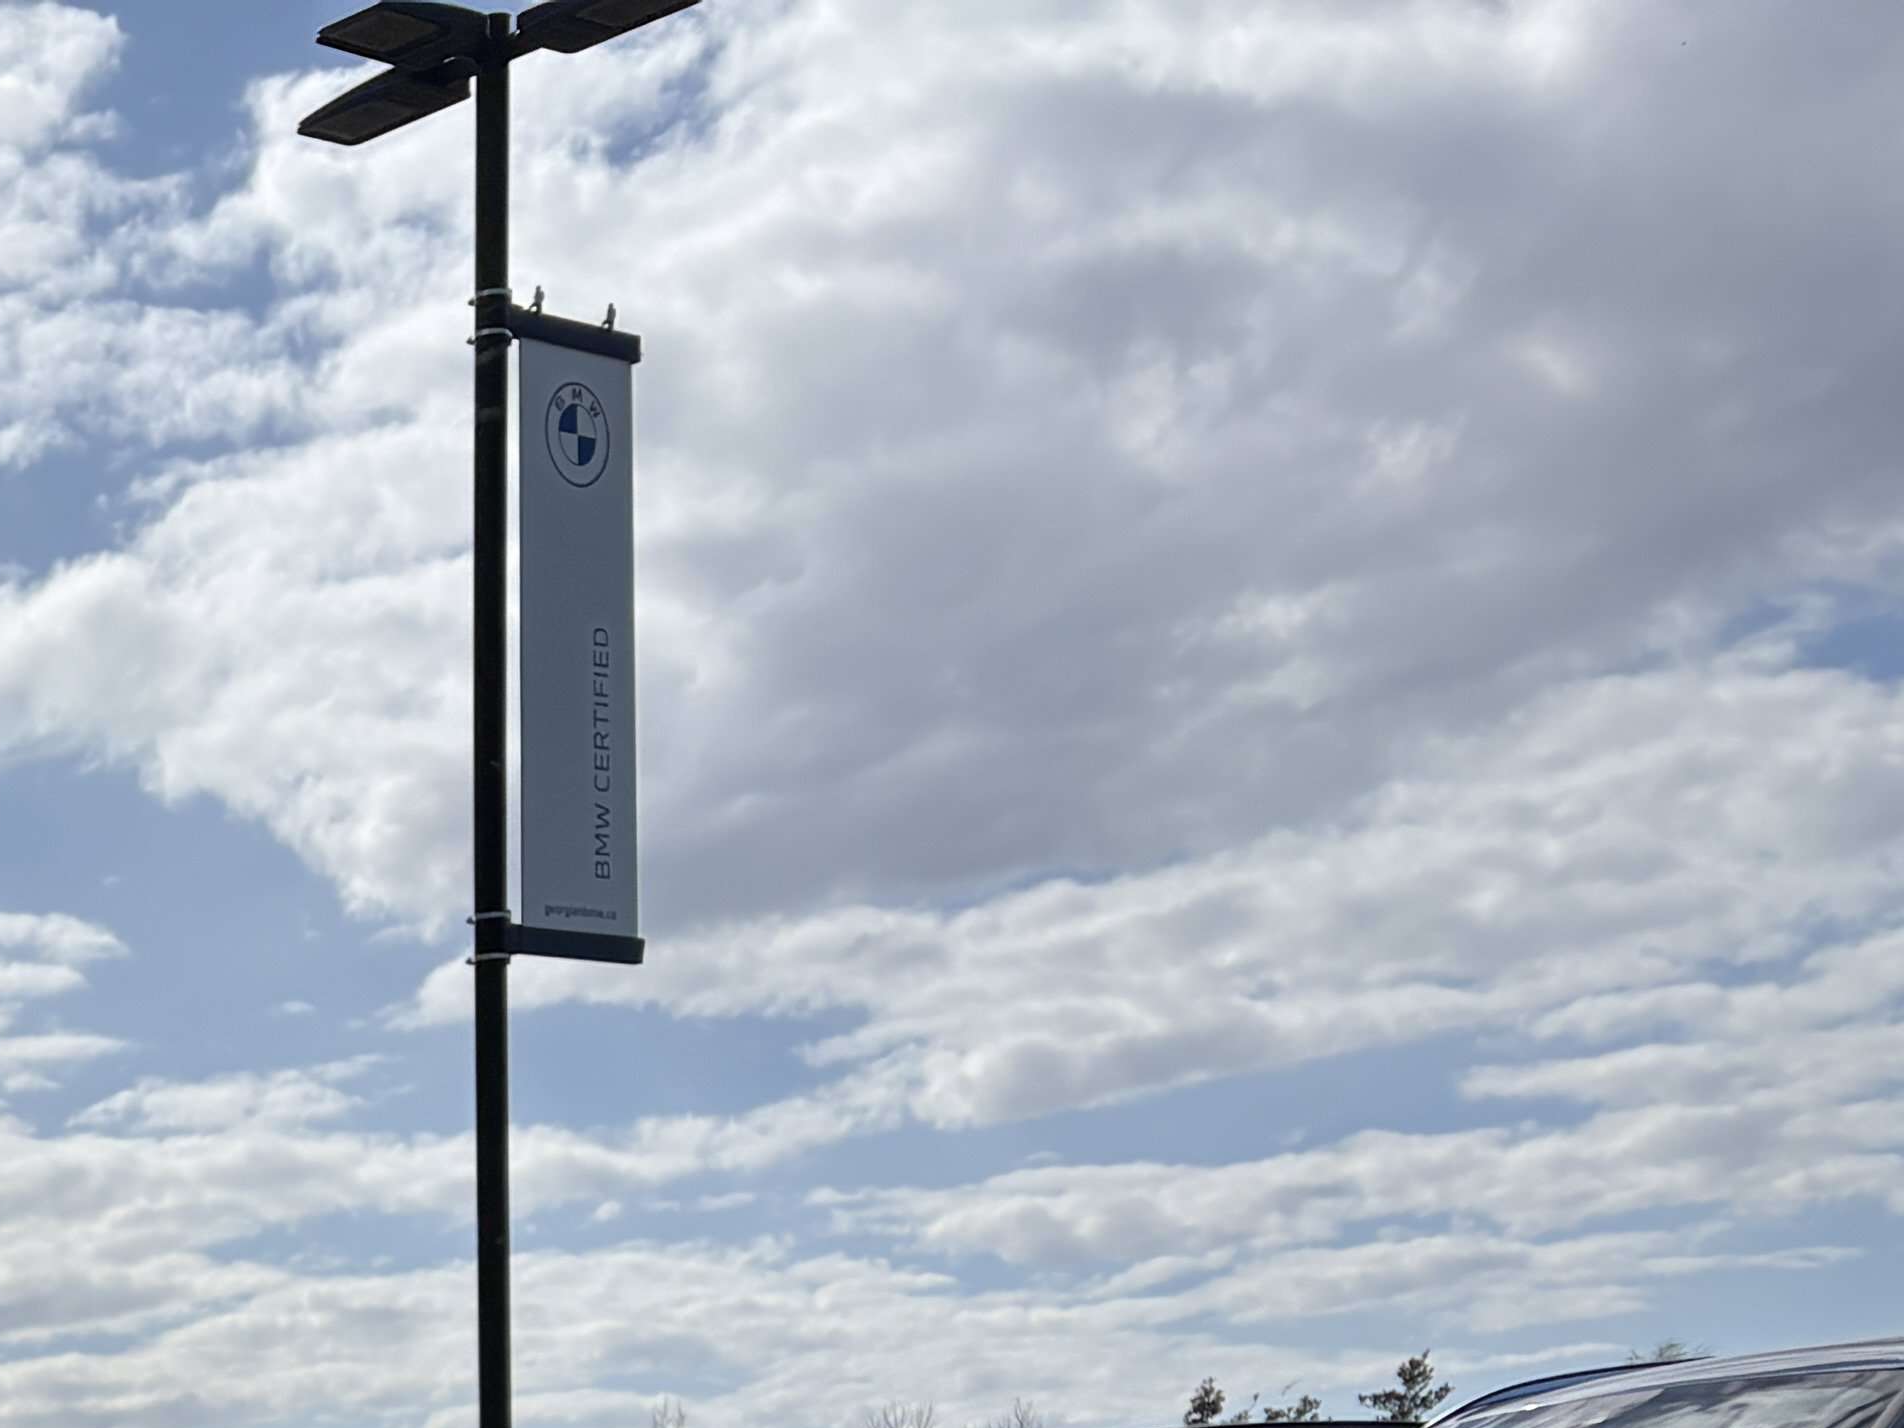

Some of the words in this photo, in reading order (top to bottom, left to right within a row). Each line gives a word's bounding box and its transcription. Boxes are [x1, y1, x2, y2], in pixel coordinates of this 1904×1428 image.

[555, 388, 601, 418] BMW
[593, 627, 610, 792] CERTIFIED
[594, 803, 611, 880] BMW
